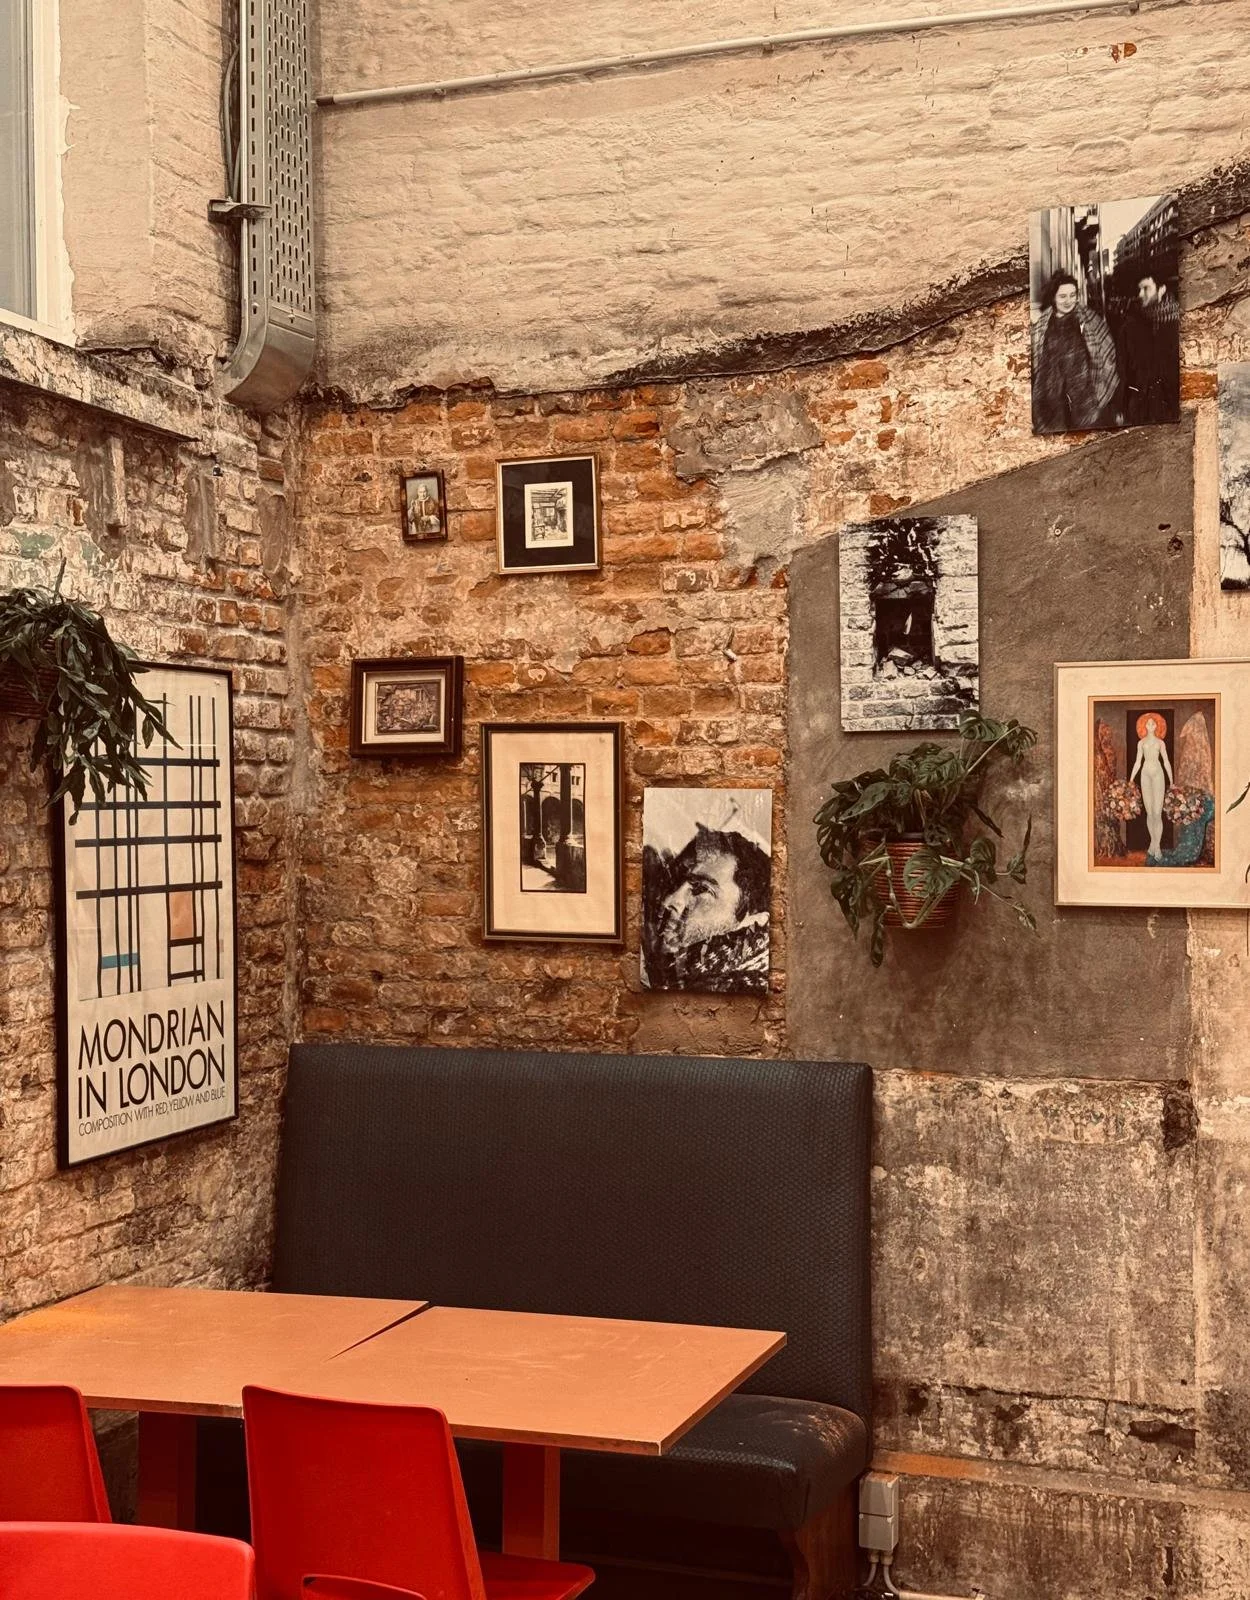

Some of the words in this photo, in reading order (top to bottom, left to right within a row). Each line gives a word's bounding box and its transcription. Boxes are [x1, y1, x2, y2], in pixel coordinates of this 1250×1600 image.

[78, 1000, 225, 1070] MONDRIAN
[78, 1071, 107, 1119] IN
[119, 1044, 225, 1109] LONDON
[78, 1110, 133, 1136] COMPOSITION
[134, 1105, 153, 1121] WITH
[195, 1090, 210, 1105] AND
[210, 1086, 226, 1101] BLUE
